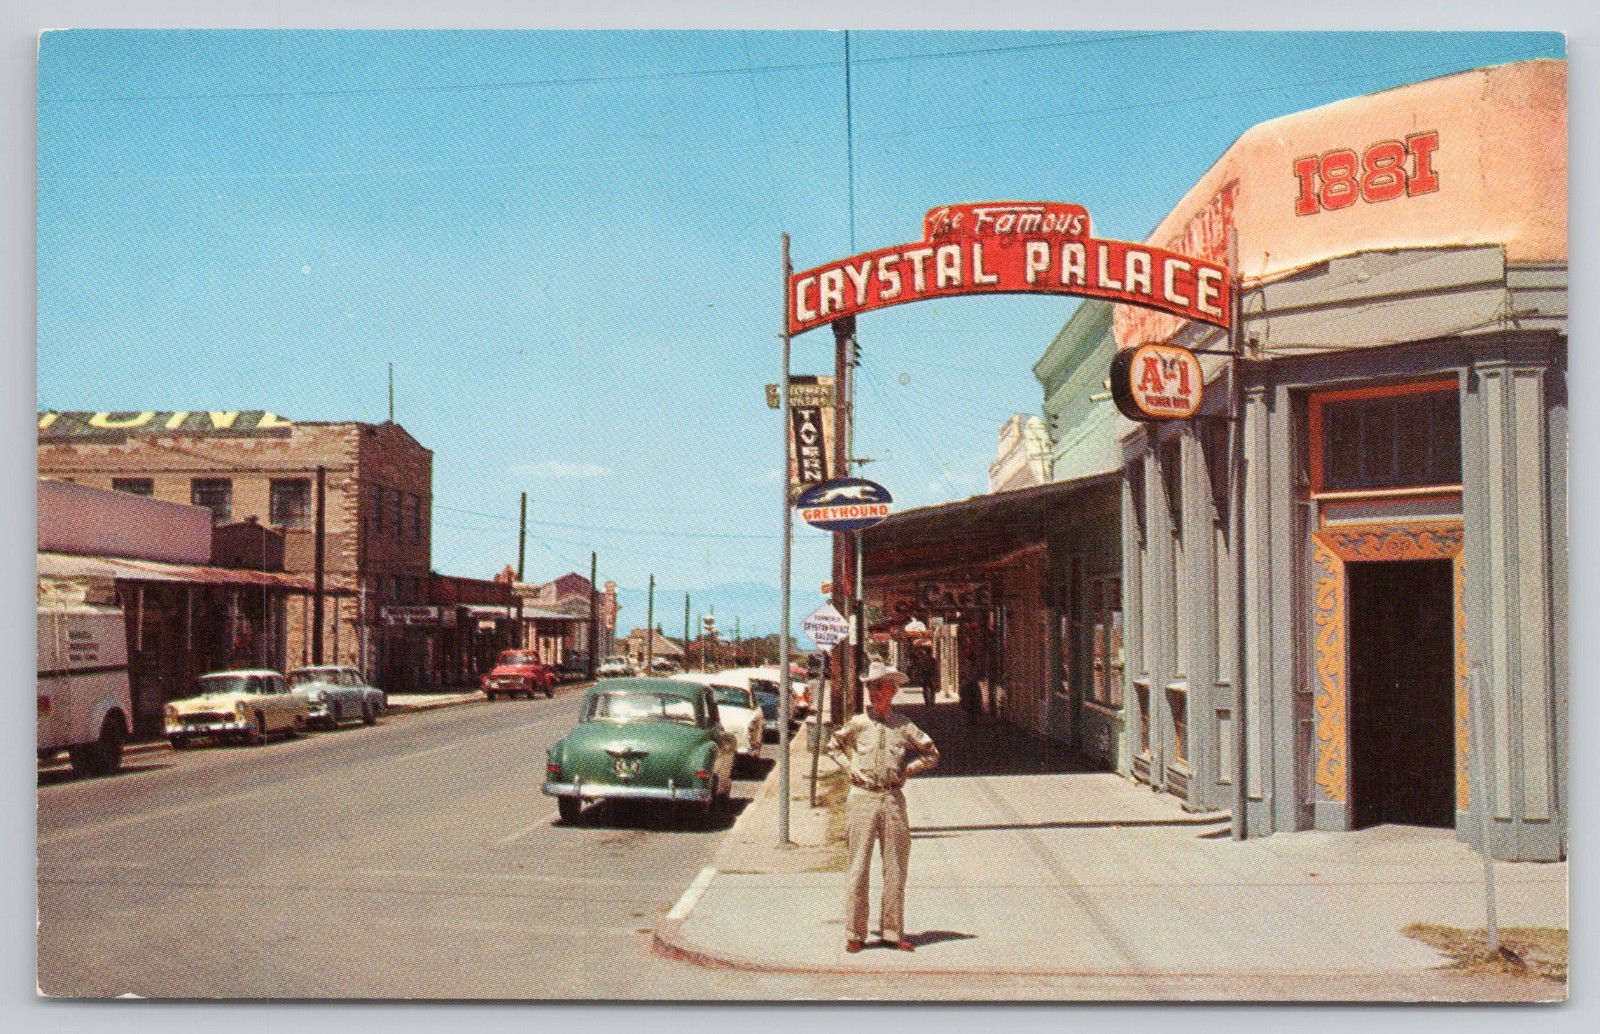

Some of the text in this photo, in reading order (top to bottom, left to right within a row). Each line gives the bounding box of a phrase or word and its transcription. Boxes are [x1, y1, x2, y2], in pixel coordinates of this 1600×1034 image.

[1294, 130, 1440, 216] 1881
[929, 206, 1087, 240] The Famous
[794, 240, 1225, 324] CRYSTAL PALACE
[1137, 356, 1193, 396] A-1
[797, 408, 823, 483] TAVERN
[803, 504, 889, 523] GREYHOUND
